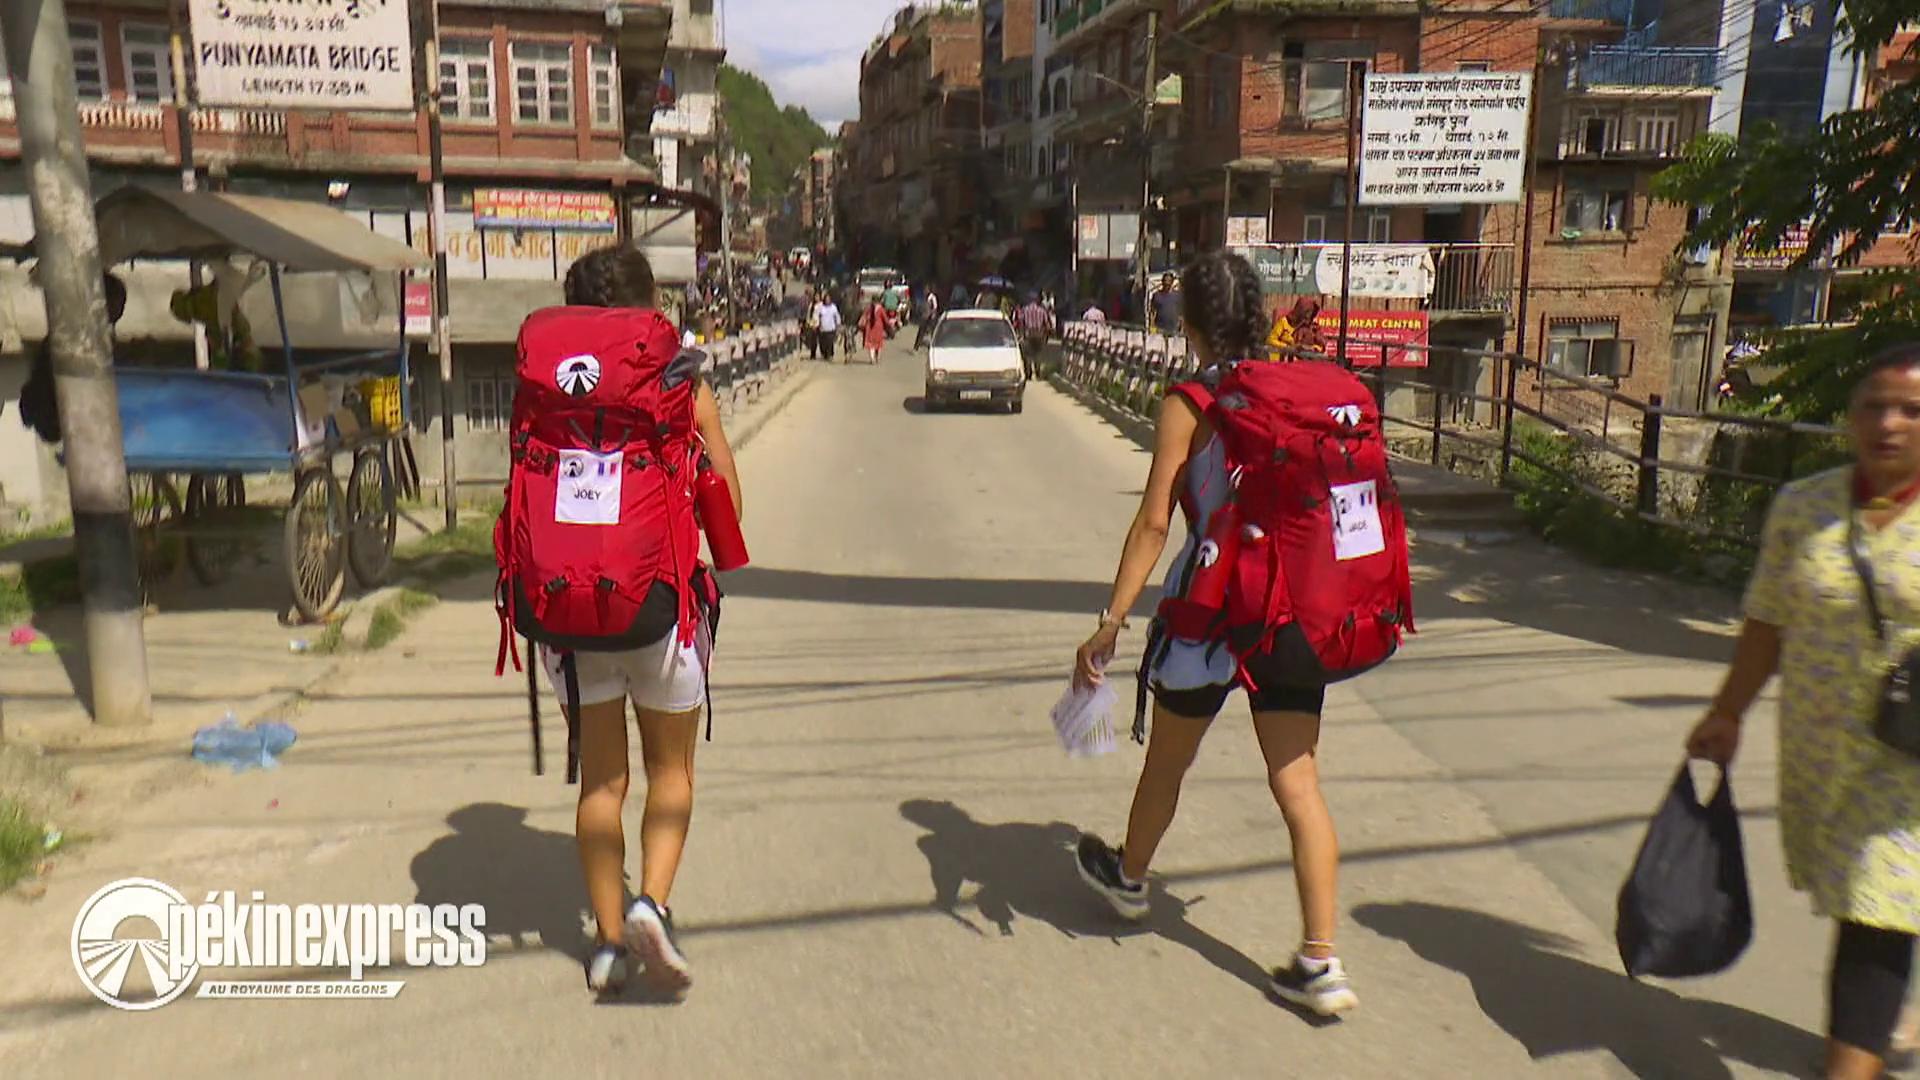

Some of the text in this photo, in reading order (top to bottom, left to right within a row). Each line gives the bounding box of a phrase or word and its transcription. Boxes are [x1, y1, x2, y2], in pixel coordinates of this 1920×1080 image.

[201, 42, 401, 72] PUNYAMATA BRIDGE
[242, 78, 304, 94] LENGTH
[1348, 319, 1379, 329] MEAT
[1381, 319, 1422, 330] CENTER
[574, 489, 601, 500] JOEY
